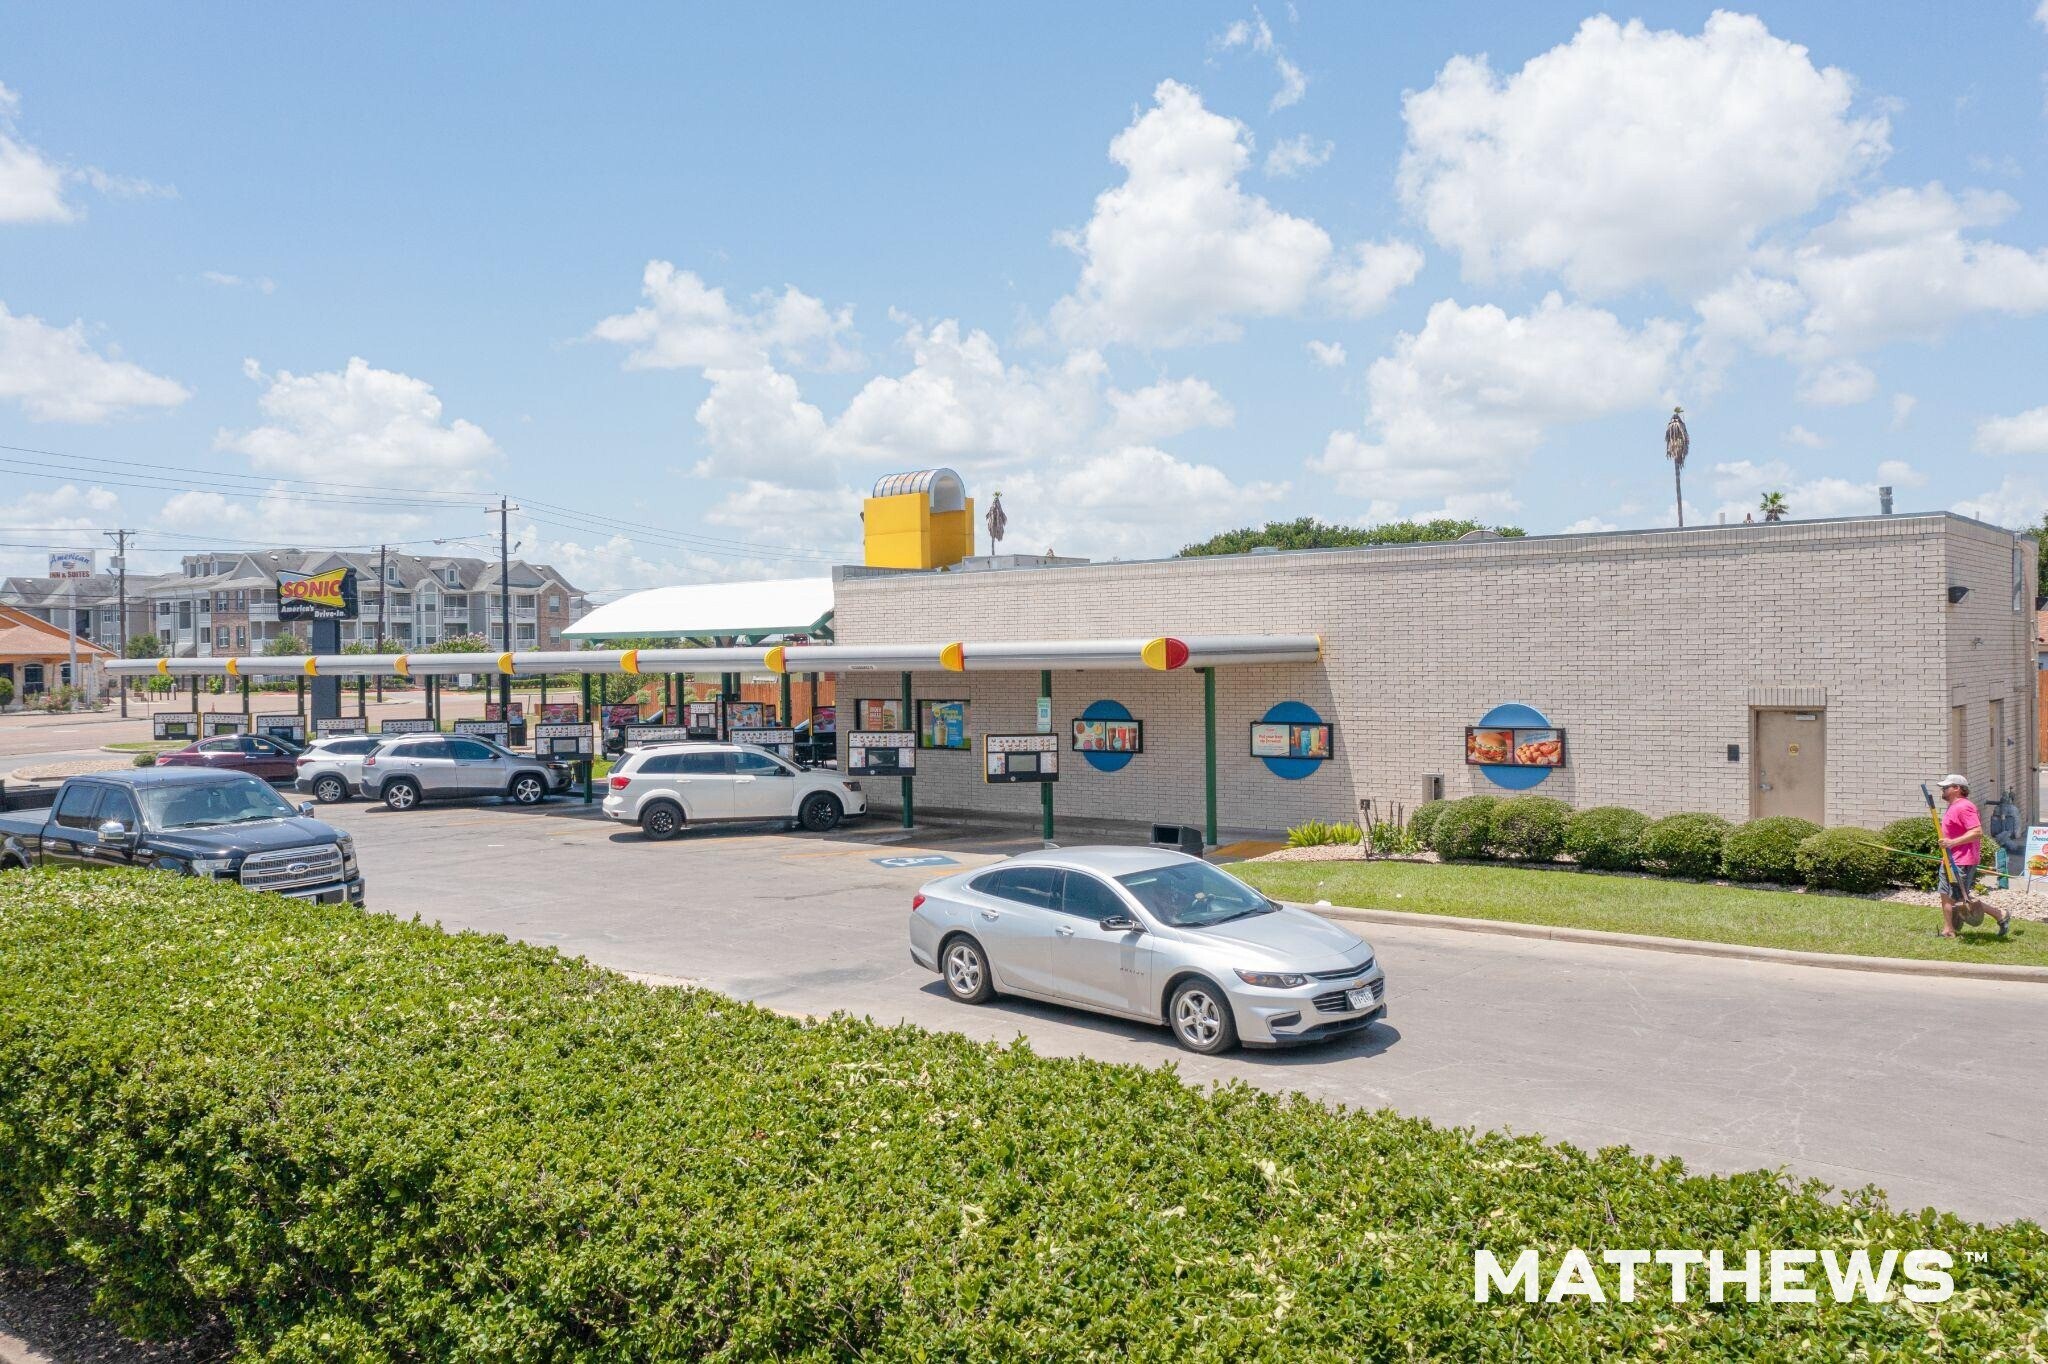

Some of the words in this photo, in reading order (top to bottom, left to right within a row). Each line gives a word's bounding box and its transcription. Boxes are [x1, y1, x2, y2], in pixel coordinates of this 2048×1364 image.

[50, 553, 90, 567] American
[67, 570, 90, 578] SUITES
[284, 580, 342, 598] SONIC
